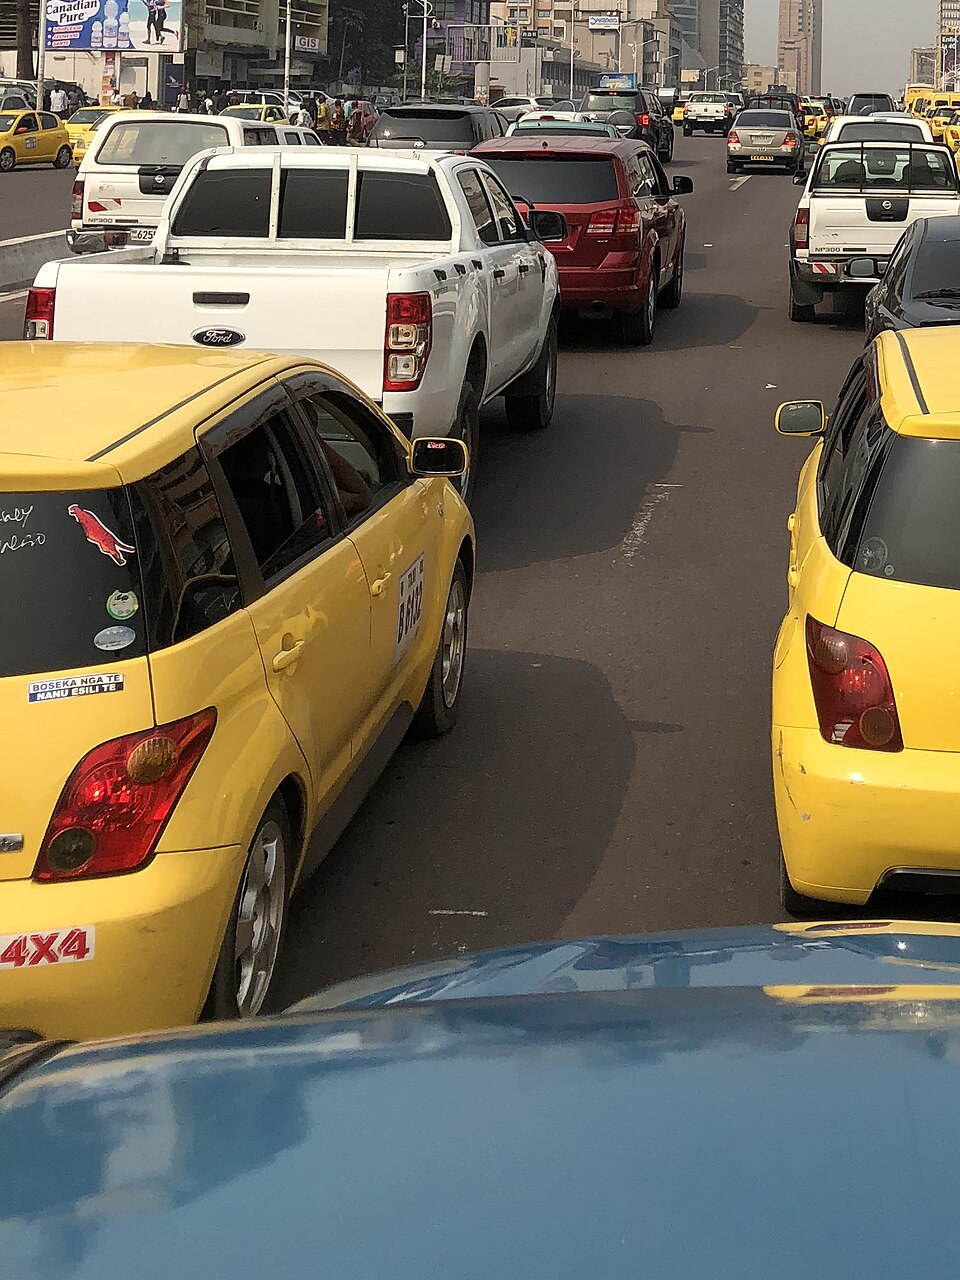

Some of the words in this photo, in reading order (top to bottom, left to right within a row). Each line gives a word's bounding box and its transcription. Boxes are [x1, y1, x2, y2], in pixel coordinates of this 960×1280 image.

[46, 0, 97, 15] Canadian
[59, 12, 85, 23] Pure
[299, 37, 317, 48] GIS
[202, 330, 233, 343] Ford
[32, 679, 77, 692] BOSEKA
[80, 676, 104, 685] NGA
[106, 674, 120, 682] TE
[36, 689, 69, 701] NANU
[71, 685, 99, 696] ESILI
[101, 683, 117, 692] TE
[0, 928, 90, 968] 4X4
